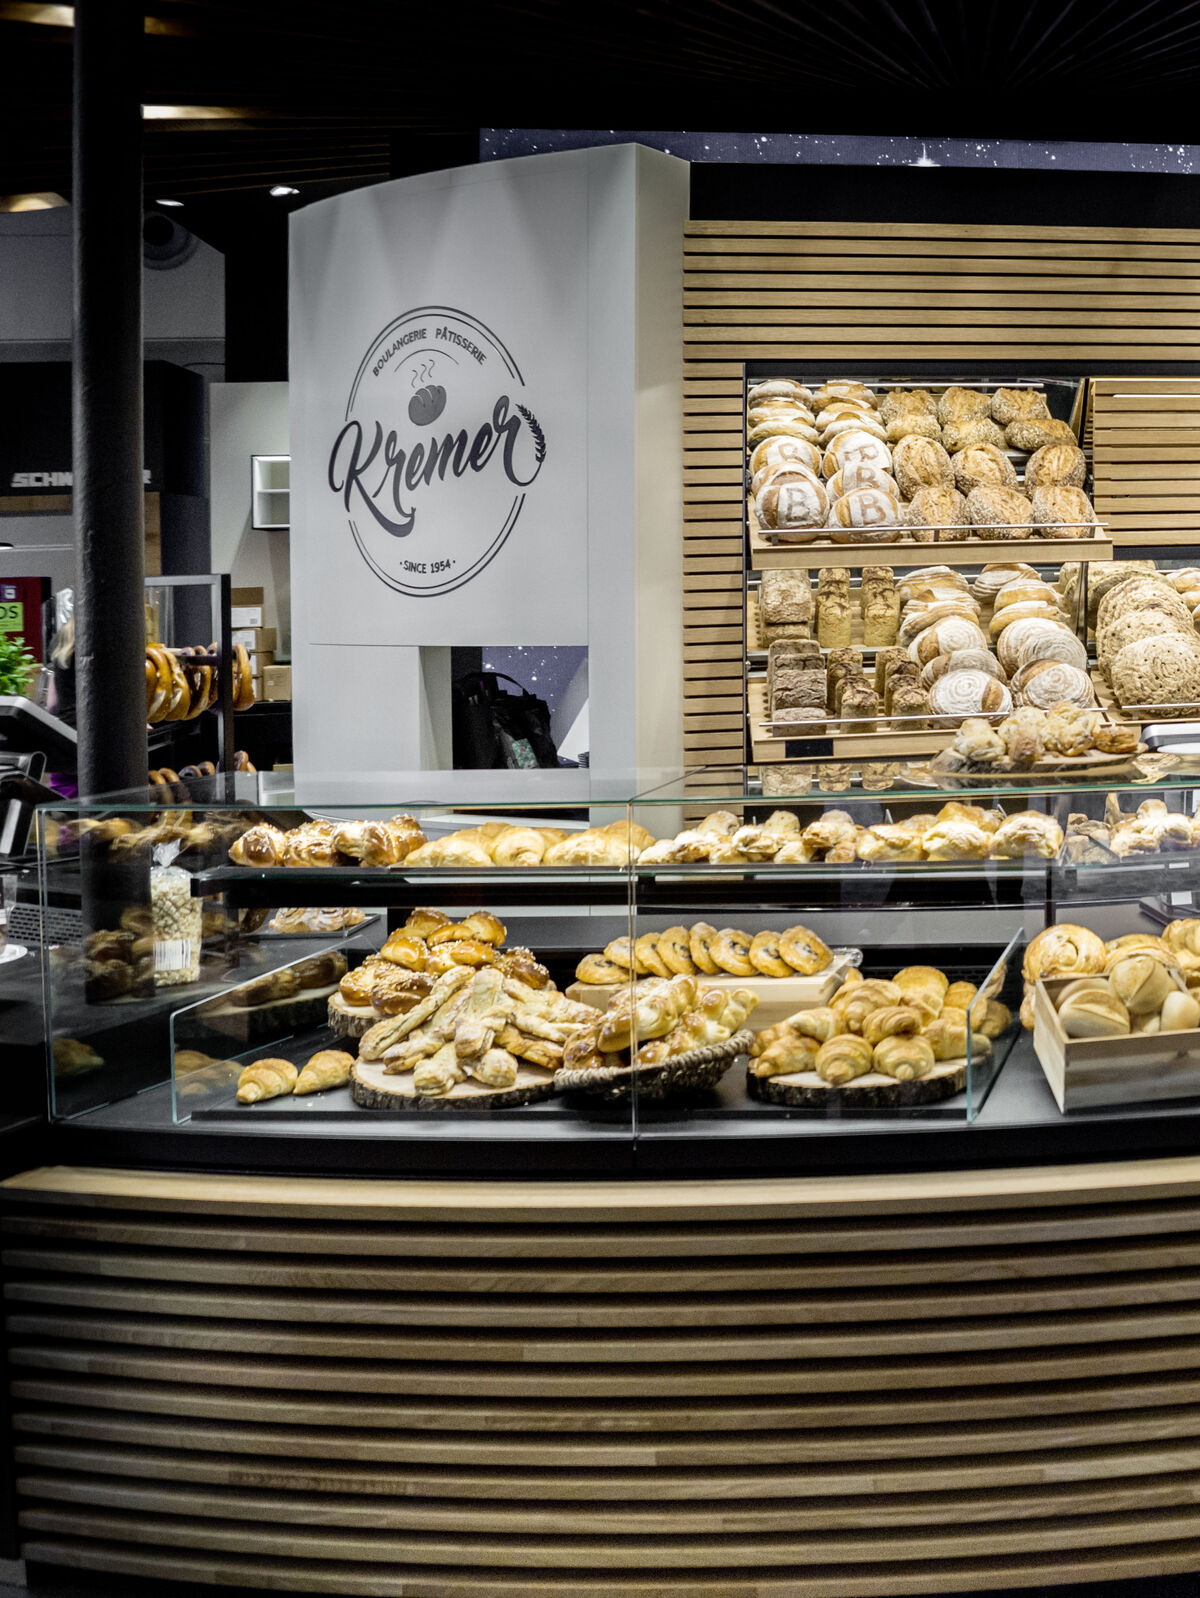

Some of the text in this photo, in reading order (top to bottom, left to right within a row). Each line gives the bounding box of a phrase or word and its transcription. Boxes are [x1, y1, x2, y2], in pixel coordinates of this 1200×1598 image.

[372, 326, 487, 377] BOULANGERIE PÂTISSERIE
[328, 395, 545, 537] Kremer
[403, 558, 451, 574] SINCE 1954
